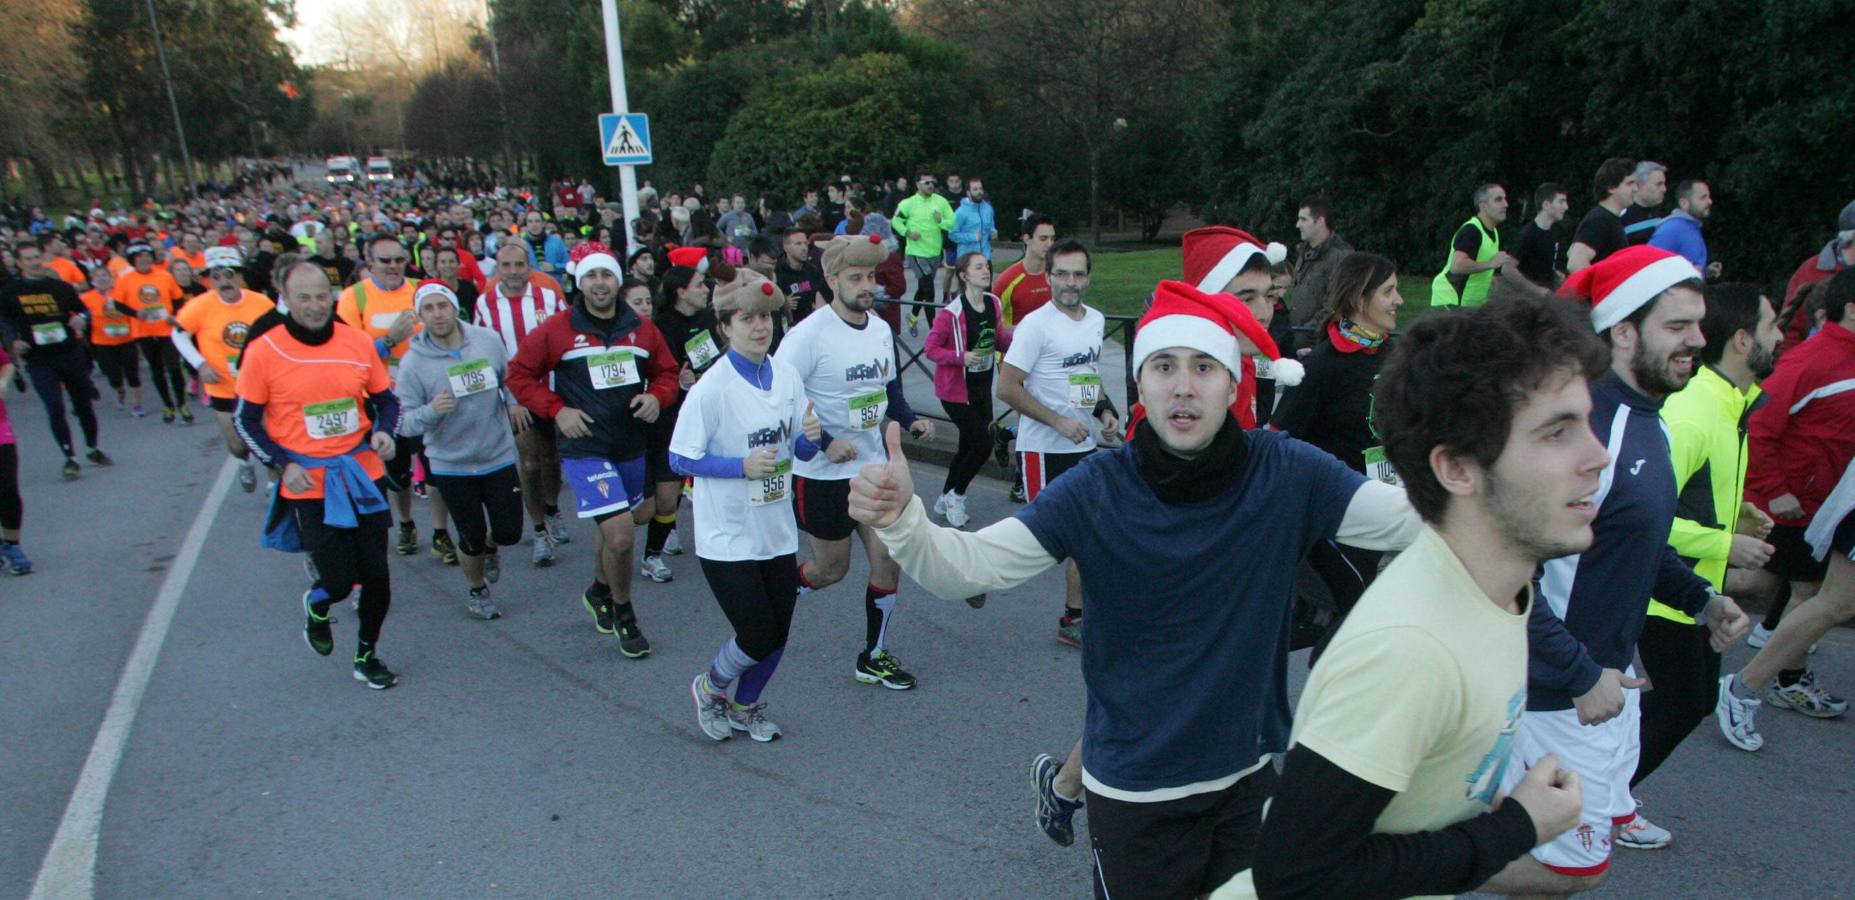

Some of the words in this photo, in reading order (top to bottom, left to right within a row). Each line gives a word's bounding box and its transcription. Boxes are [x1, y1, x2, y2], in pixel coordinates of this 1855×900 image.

[460, 370, 486, 387] 1795
[600, 363, 626, 379] 1794
[316, 411, 348, 429] 2497
[861, 404, 879, 422] 952
[763, 475, 784, 494] 956
